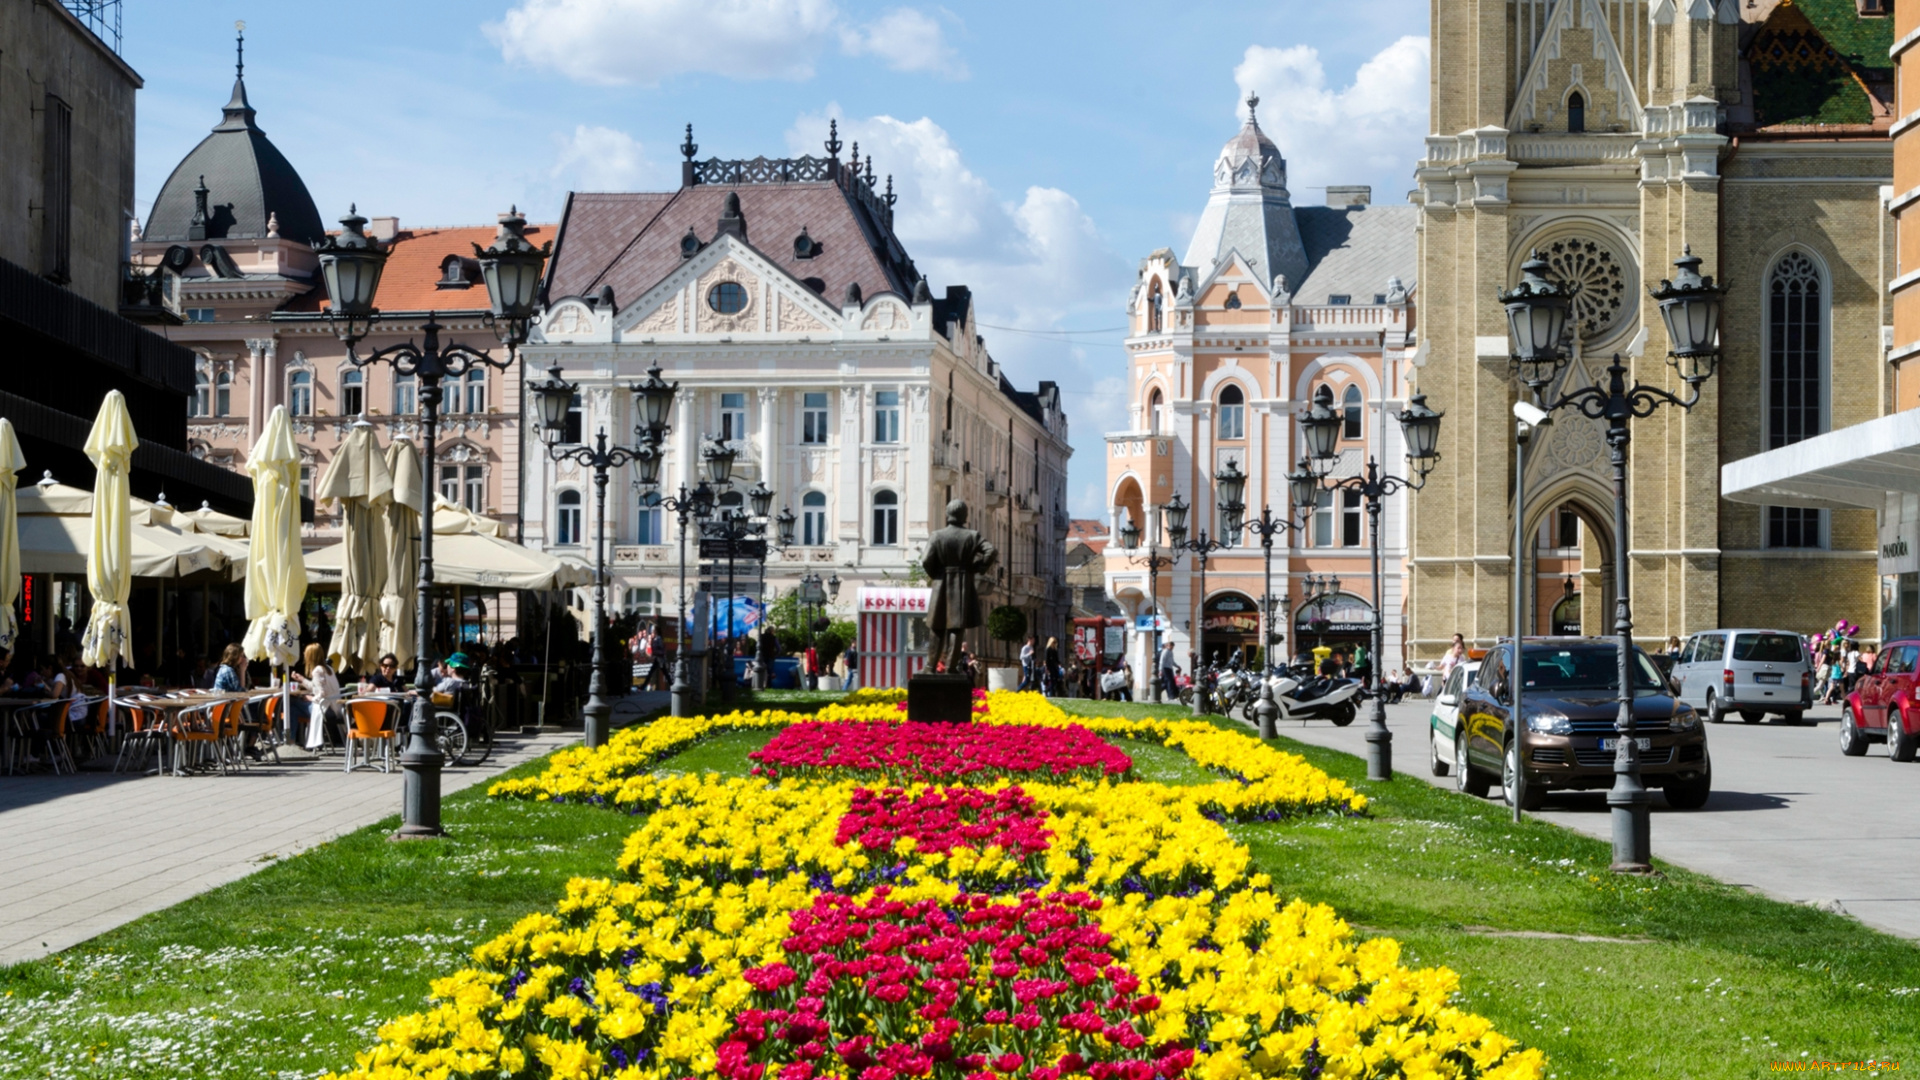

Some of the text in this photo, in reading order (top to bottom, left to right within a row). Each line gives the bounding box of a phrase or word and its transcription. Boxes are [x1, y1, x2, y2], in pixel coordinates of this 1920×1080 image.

[865, 598, 925, 607] KOK ICE
[1204, 615, 1258, 631] CABARET
